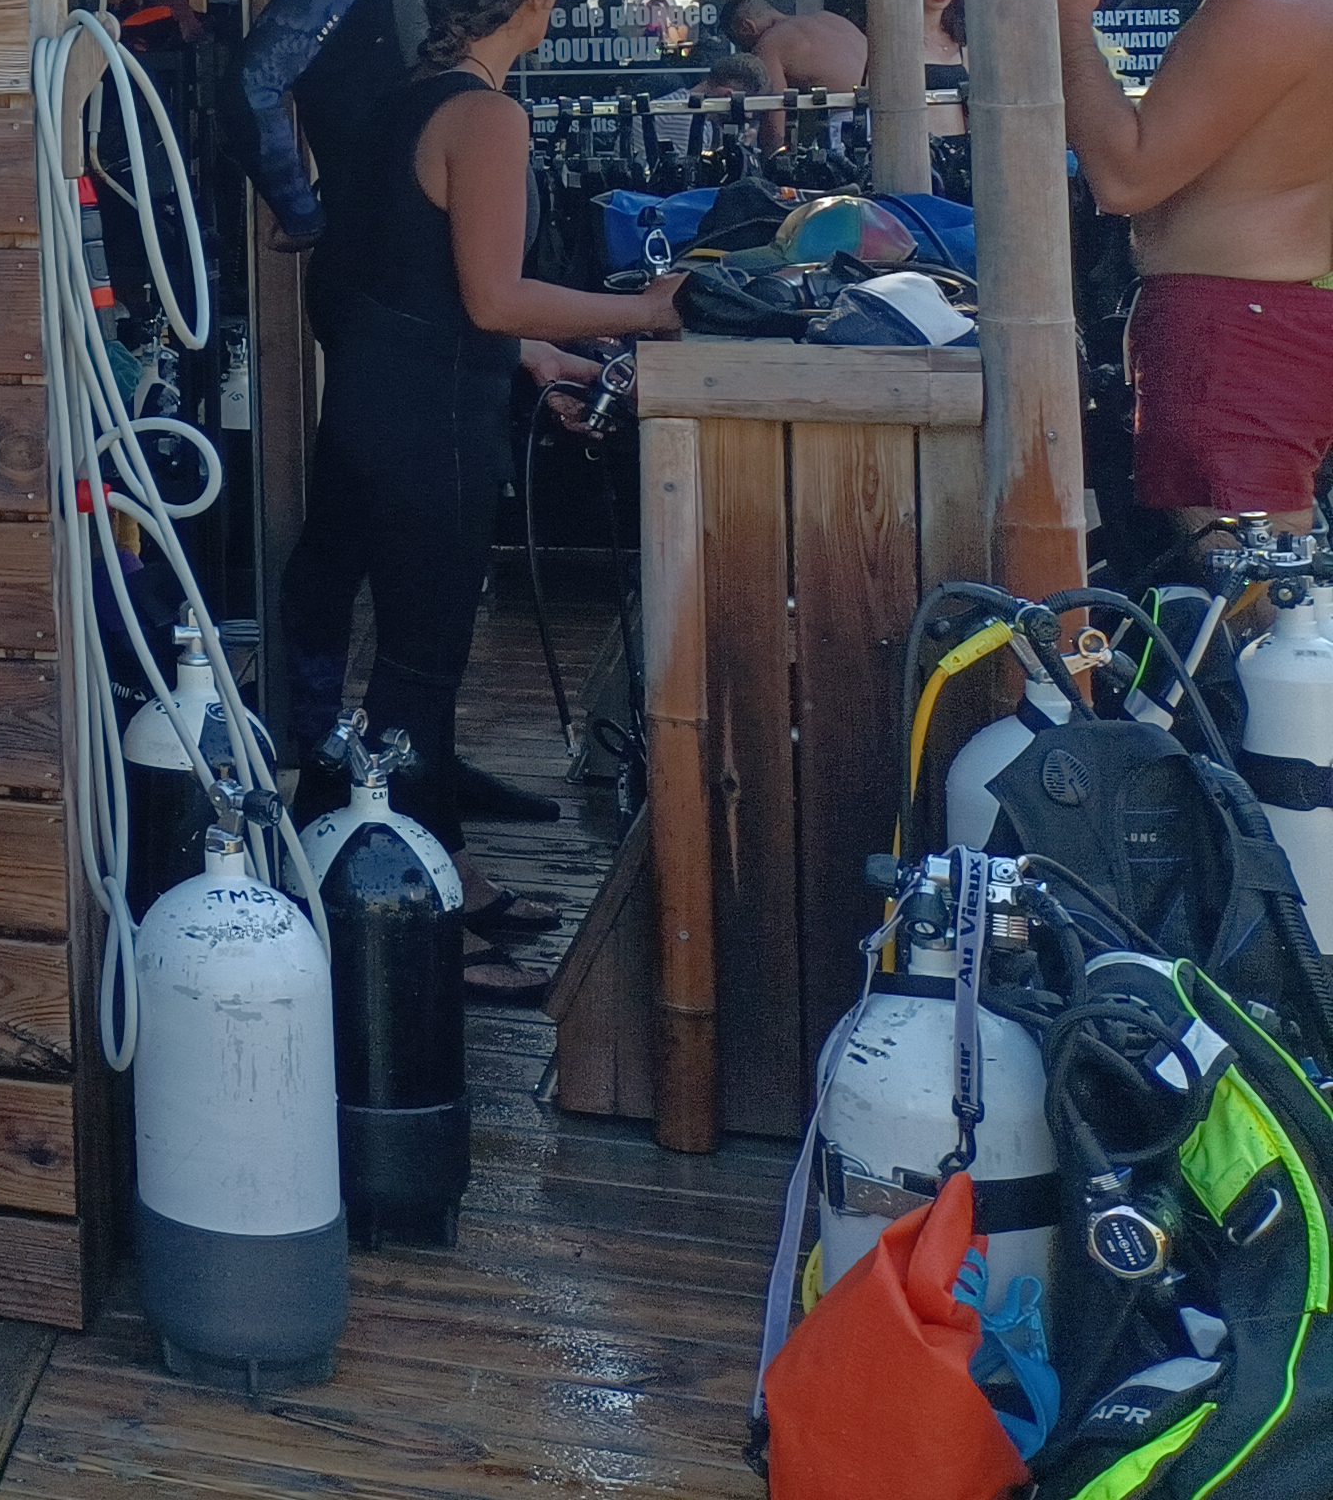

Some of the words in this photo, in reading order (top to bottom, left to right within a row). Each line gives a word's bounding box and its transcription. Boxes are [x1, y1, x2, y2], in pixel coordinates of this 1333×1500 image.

[571, 3, 605, 28] de
[959, 858, 983, 936] Vieux
[958, 947, 974, 988] Au
